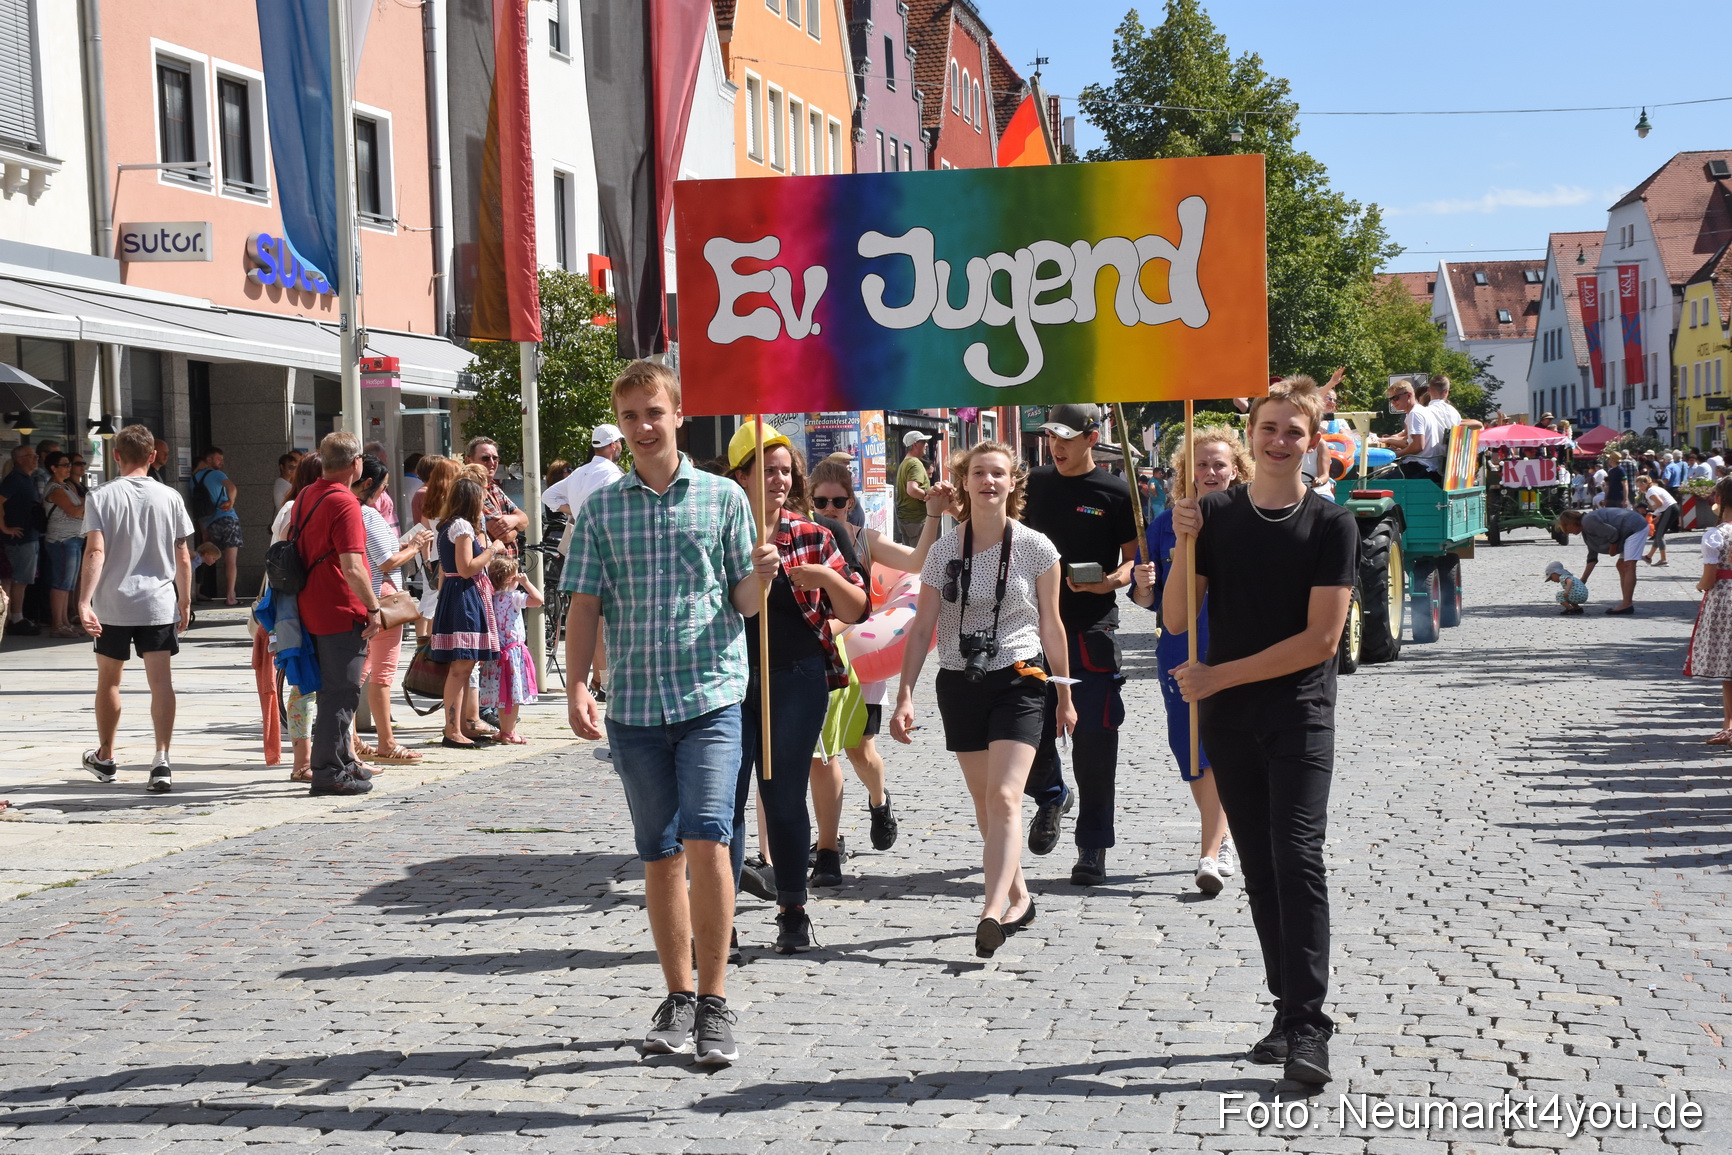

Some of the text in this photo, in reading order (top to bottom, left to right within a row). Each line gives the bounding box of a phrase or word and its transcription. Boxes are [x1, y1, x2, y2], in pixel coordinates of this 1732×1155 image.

[703, 195, 1210, 387] Ev. Jugend
[1621, 269, 1632, 297] K&L
[848, 417, 860, 425] 2019
[1027, 408, 1042, 418] FASS
[1504, 459, 1555, 486] KAB
[999, 561, 1007, 580] Canon
